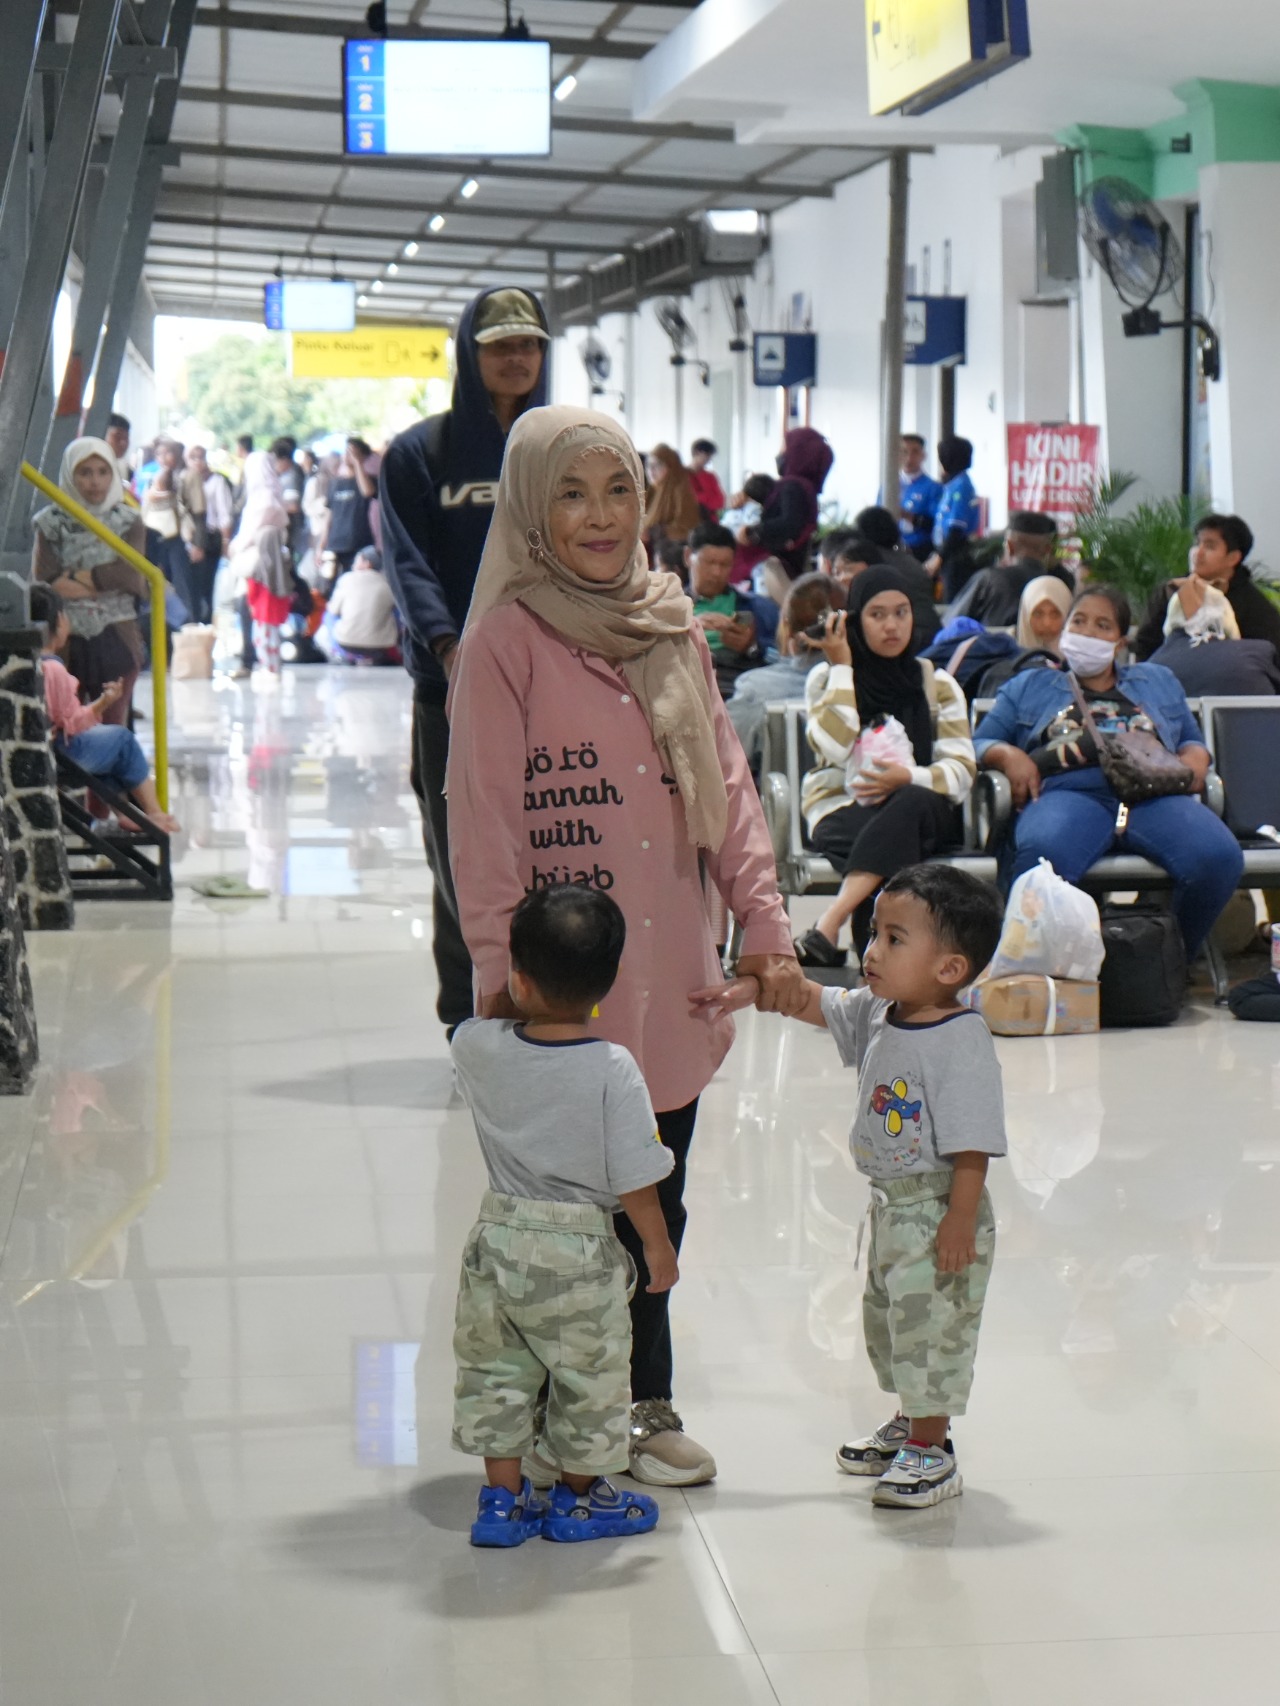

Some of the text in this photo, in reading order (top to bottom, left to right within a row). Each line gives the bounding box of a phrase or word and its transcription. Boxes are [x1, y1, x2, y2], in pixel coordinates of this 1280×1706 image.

[361, 54, 370, 72] 1
[358, 92, 373, 112] 2
[359, 130, 373, 149] 3
[1026, 433, 1080, 460] KINI
[1011, 460, 1094, 488] HADIR
[529, 818, 603, 850] with
